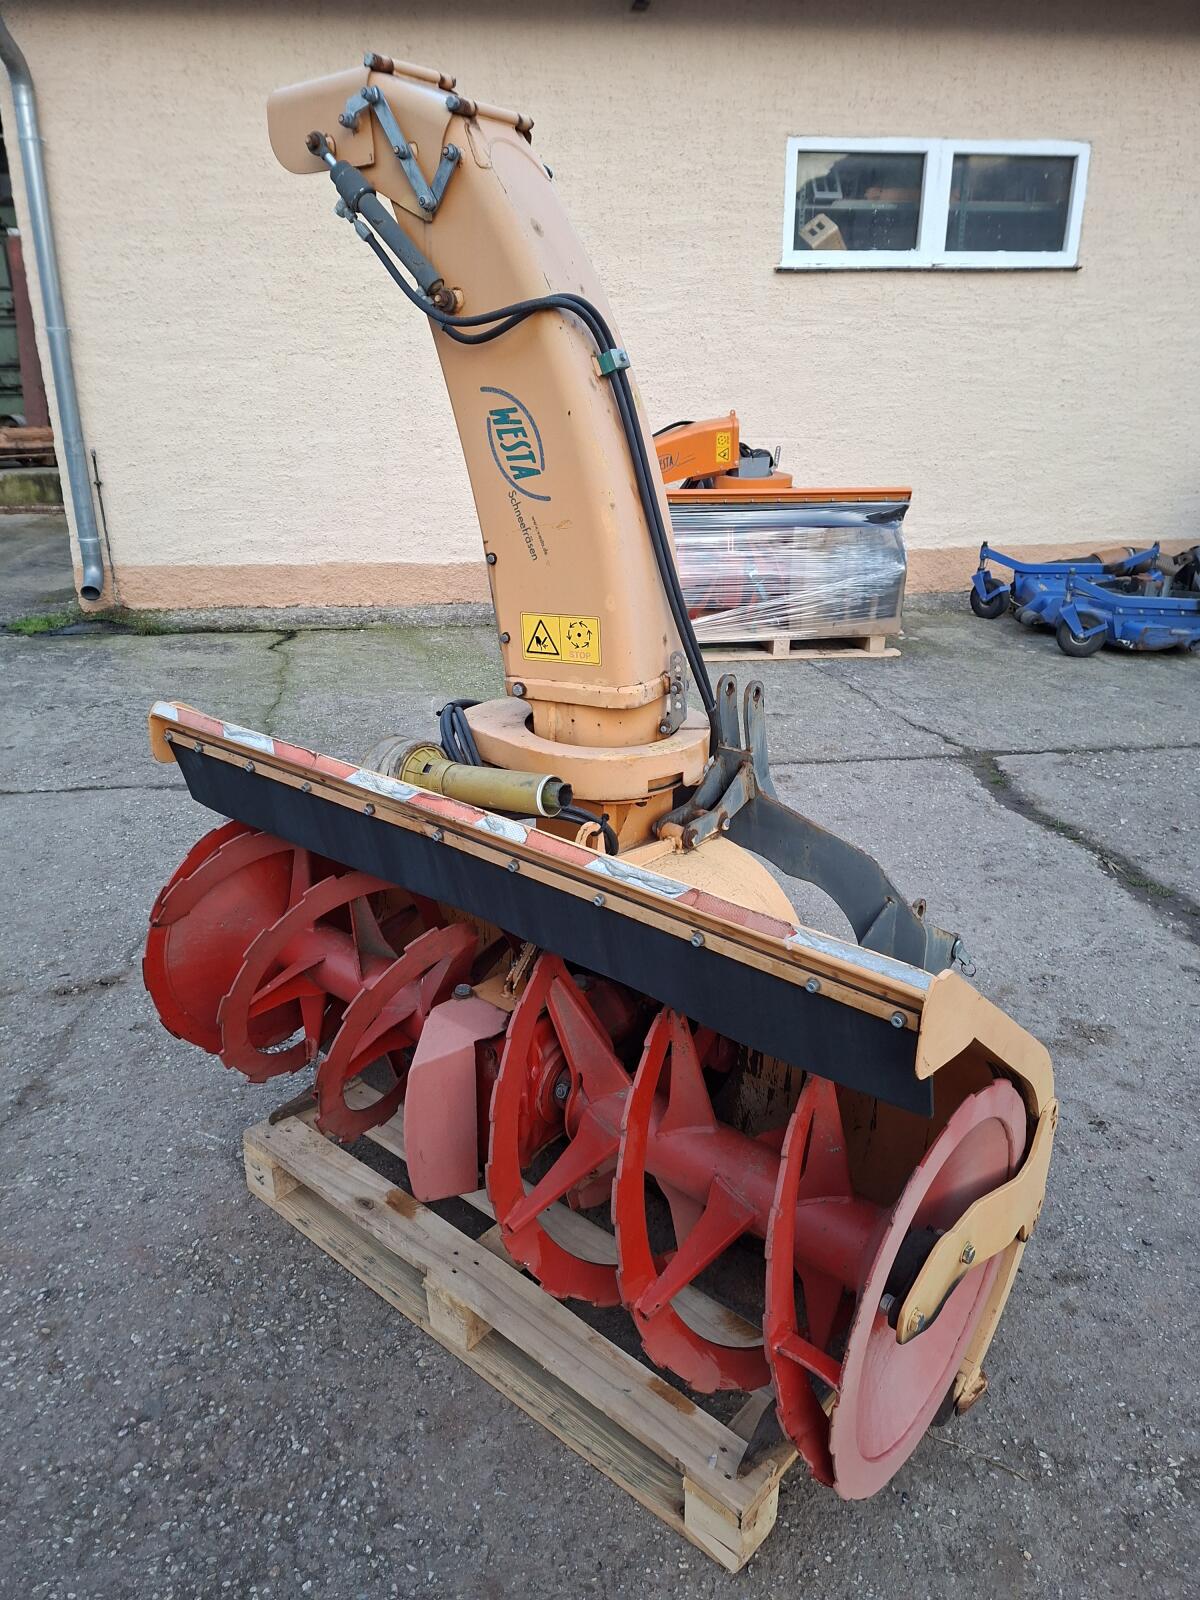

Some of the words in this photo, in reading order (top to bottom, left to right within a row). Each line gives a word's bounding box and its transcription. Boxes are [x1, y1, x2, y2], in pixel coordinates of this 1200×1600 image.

[489, 407, 541, 480] WESTA
[657, 454, 673, 469] ESTA
[508, 490, 538, 561] Schneefräsen
[569, 650, 591, 660] STOP
